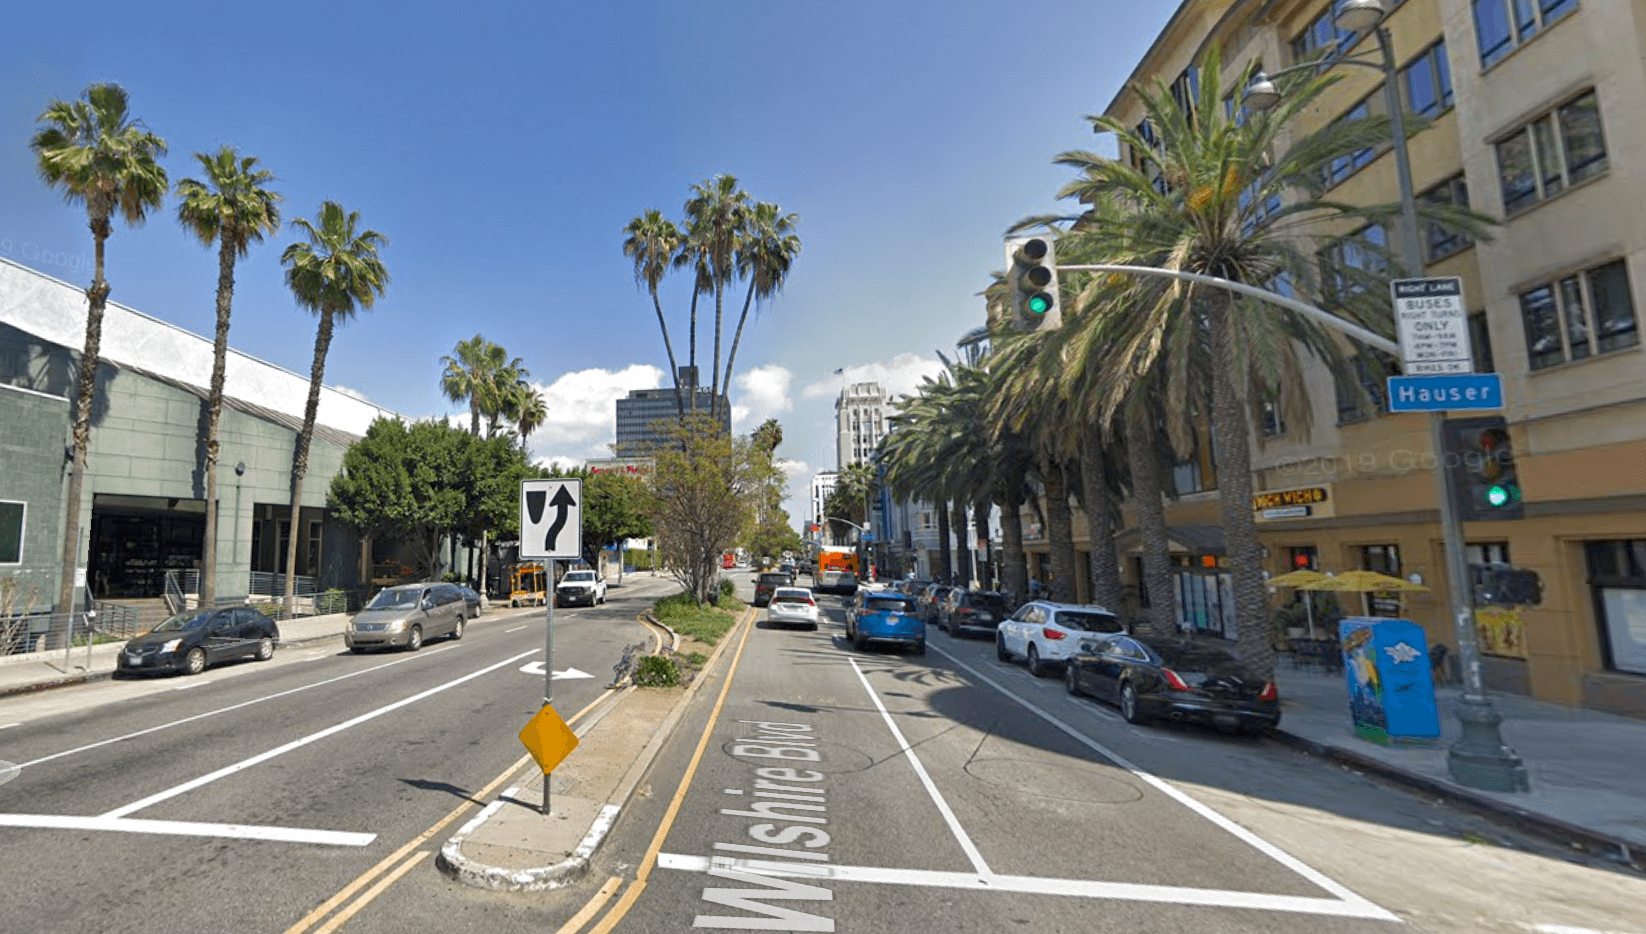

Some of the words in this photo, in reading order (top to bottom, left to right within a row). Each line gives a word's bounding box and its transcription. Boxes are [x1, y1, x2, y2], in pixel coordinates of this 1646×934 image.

[1397, 284, 1426, 293] RIGHT
[1429, 282, 1456, 291] LANE
[1405, 298, 1453, 310] BUSES
[1413, 321, 1449, 332] ONLY
[1398, 385, 1490, 402] Hauser
